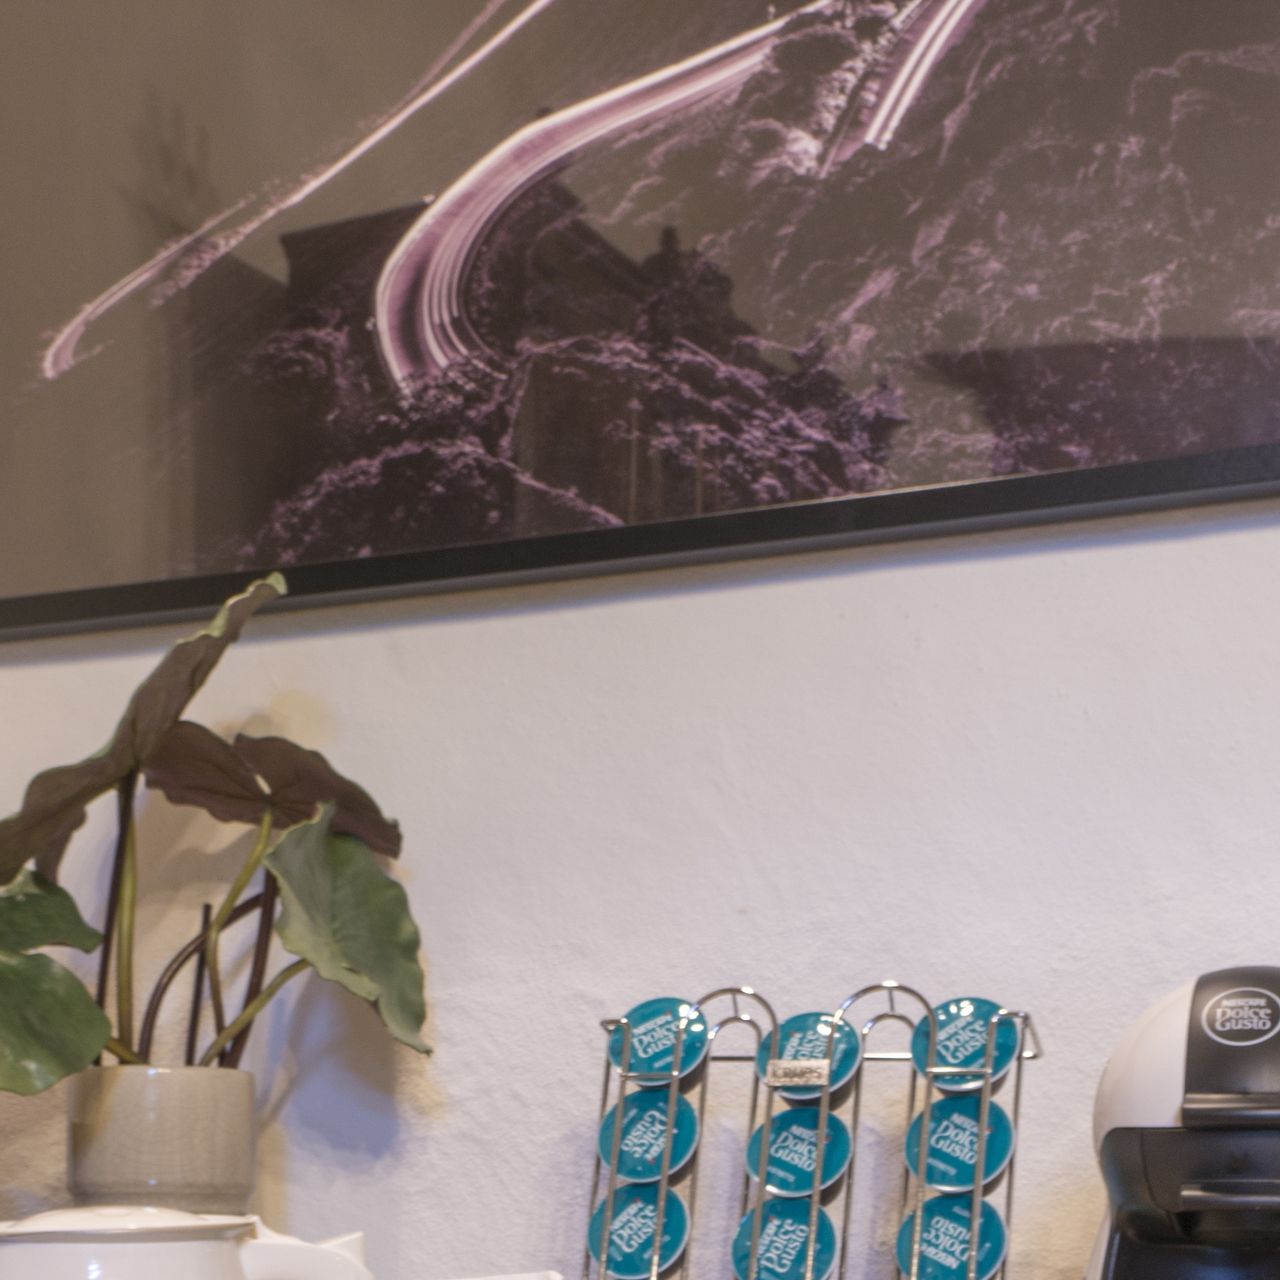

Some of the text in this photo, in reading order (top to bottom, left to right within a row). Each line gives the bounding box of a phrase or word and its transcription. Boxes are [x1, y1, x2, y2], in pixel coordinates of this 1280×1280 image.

[1215, 1018, 1271, 1031] Gusto
[1216, 1006, 1272, 1020] Dolce
[776, 1131, 818, 1159] Dolc
[937, 1121, 979, 1149] Dolc
[931, 1216, 973, 1241] usto
[762, 1218, 798, 1269] Dolce
[775, 1225, 810, 1273] Gusto
